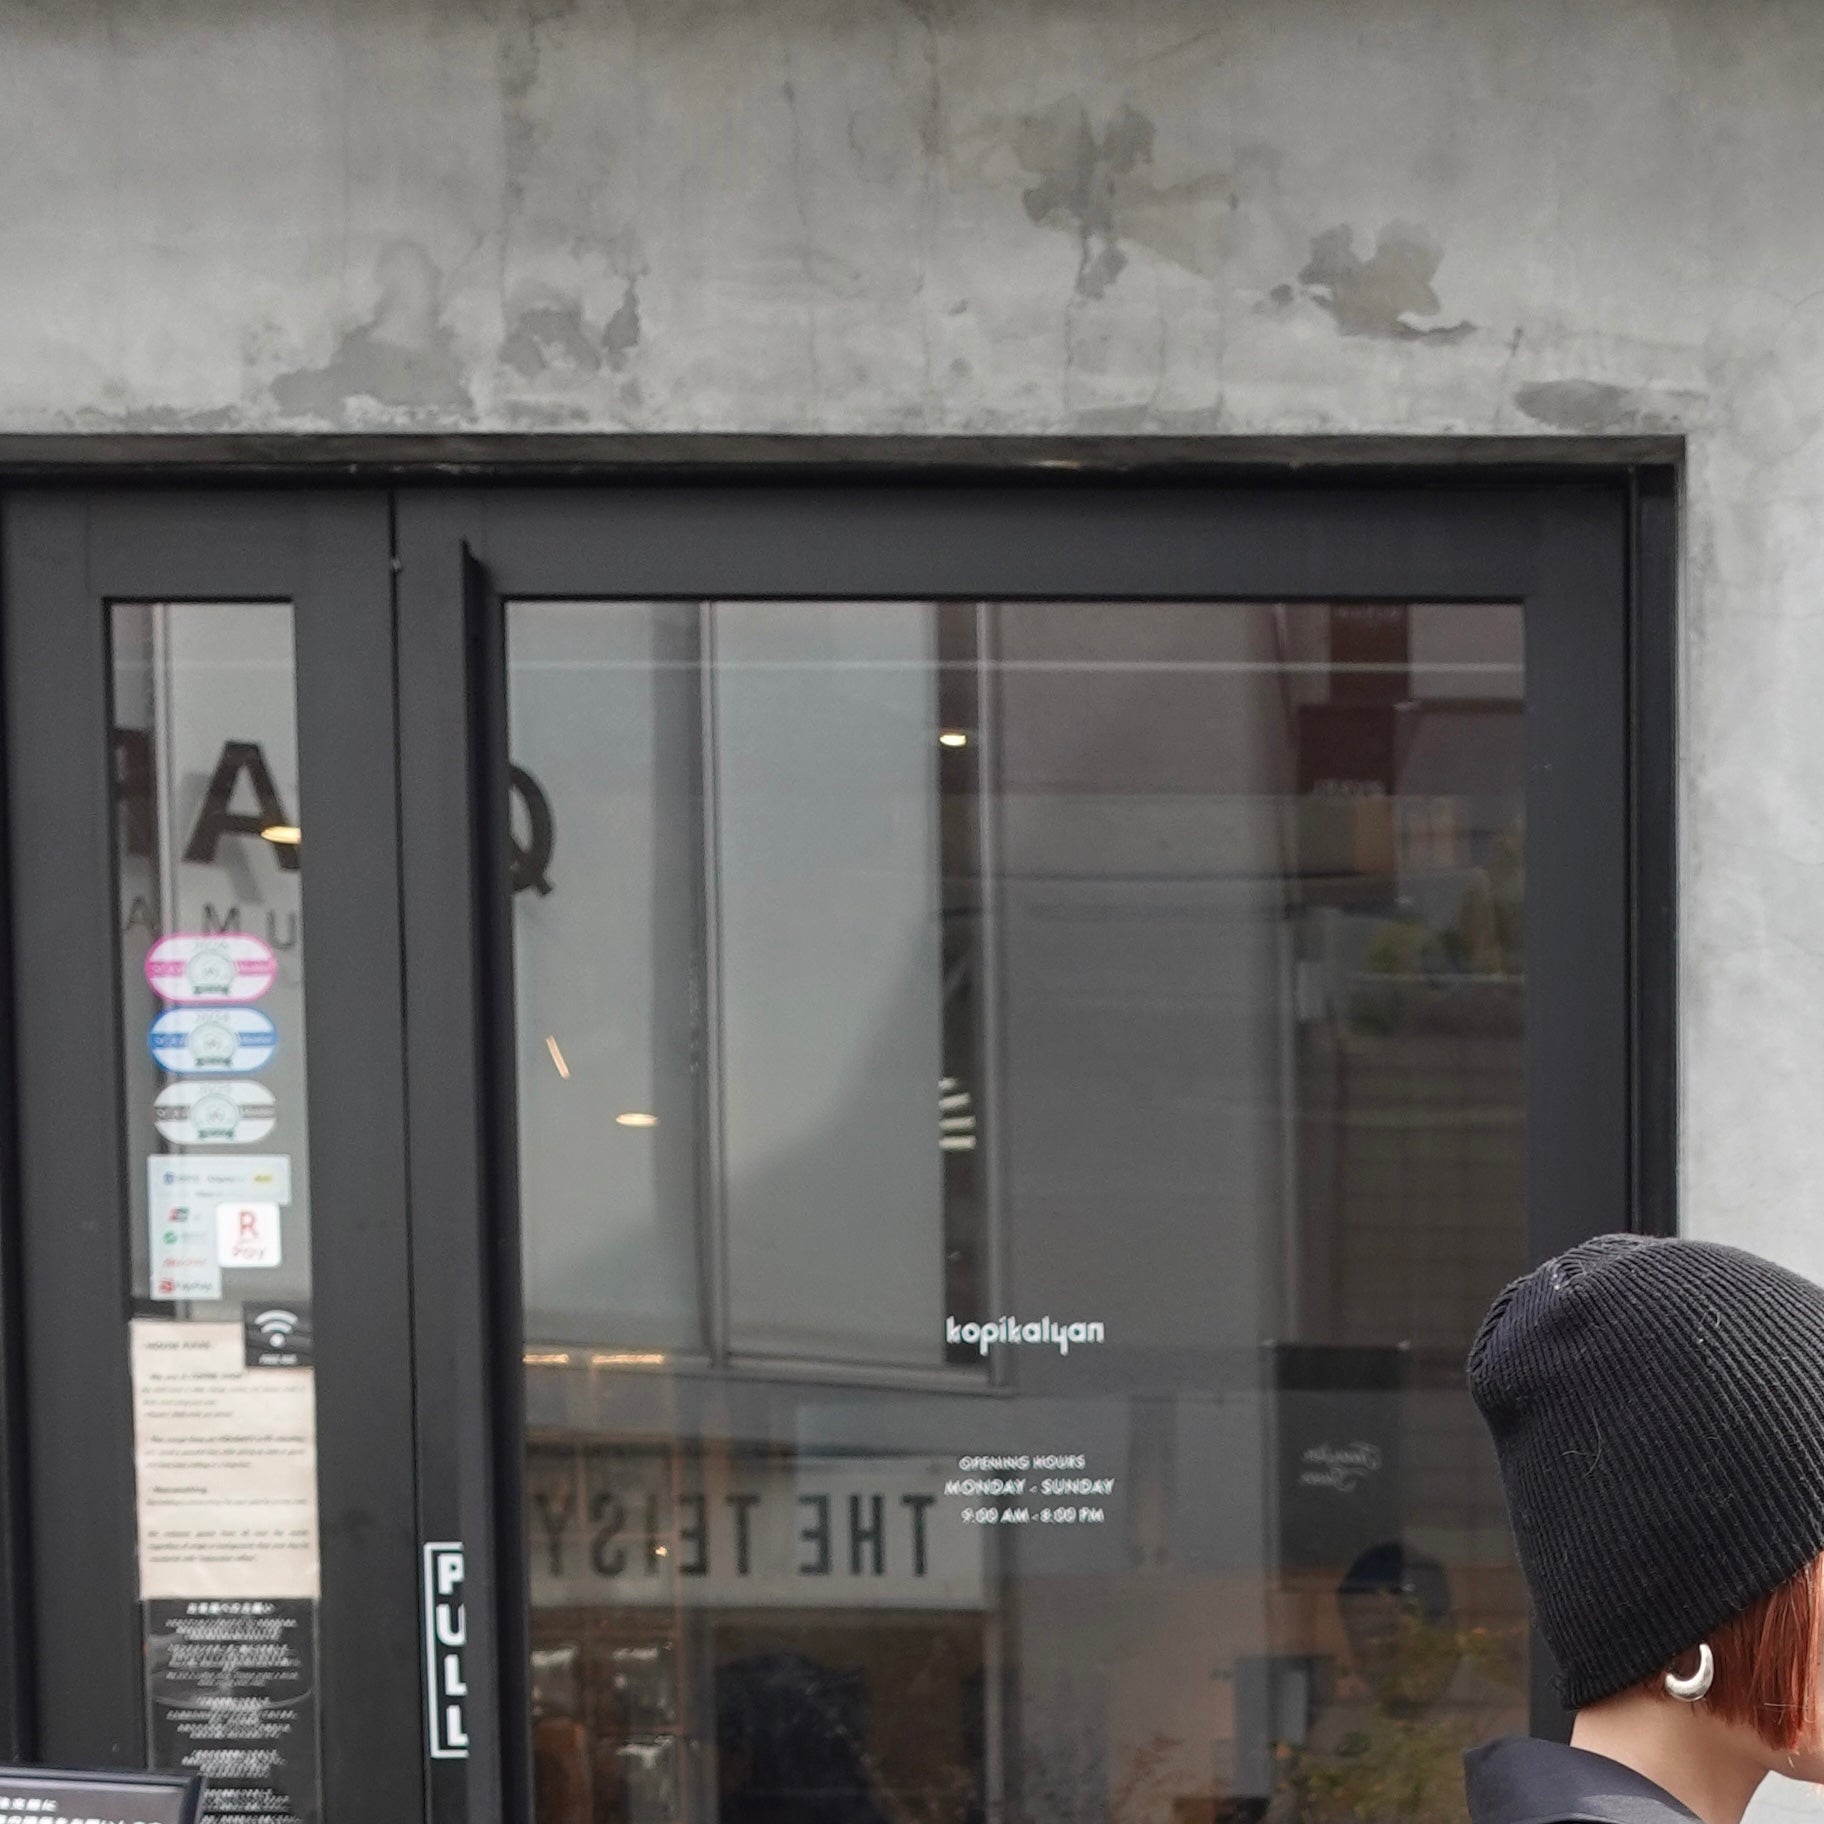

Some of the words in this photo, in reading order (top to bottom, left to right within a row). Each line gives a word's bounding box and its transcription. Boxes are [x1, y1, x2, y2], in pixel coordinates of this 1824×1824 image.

[946, 1316, 1105, 1356] kopikalyan
[958, 1456, 1031, 1471] OPENING
[1033, 1455, 1086, 1470] HOURS
[944, 1479, 1027, 1496] MONDAY
[1040, 1479, 1115, 1496] SUNDAY
[1078, 1507, 1105, 1523] PM
[435, 1553, 469, 1747] PULL
